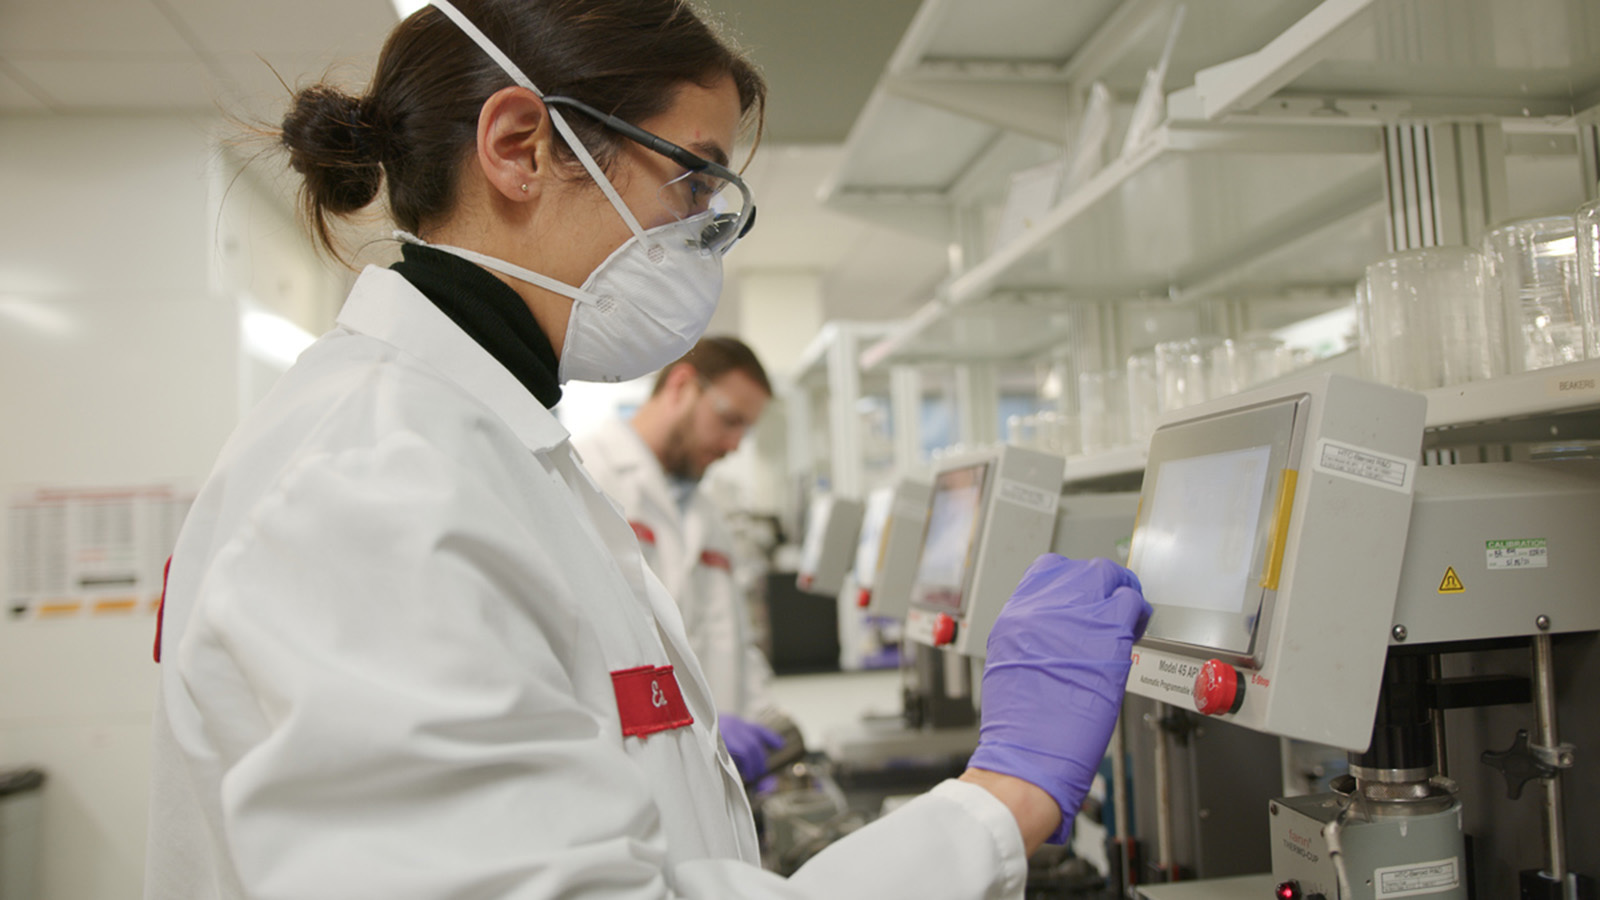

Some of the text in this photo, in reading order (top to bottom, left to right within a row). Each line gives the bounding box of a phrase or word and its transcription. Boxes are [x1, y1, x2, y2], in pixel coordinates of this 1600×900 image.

[1559, 379, 1595, 391] BEAKERS
[1488, 540, 1546, 549] CALIBRATION
[1159, 659, 1178, 674] Model
[1178, 664, 1188, 677] 45
[1140, 675, 1160, 687] Automatic
[1160, 680, 1190, 696] Programmable
[1252, 674, 1270, 687] E-Stop
[1282, 838, 1320, 863] THERMO-CUP
